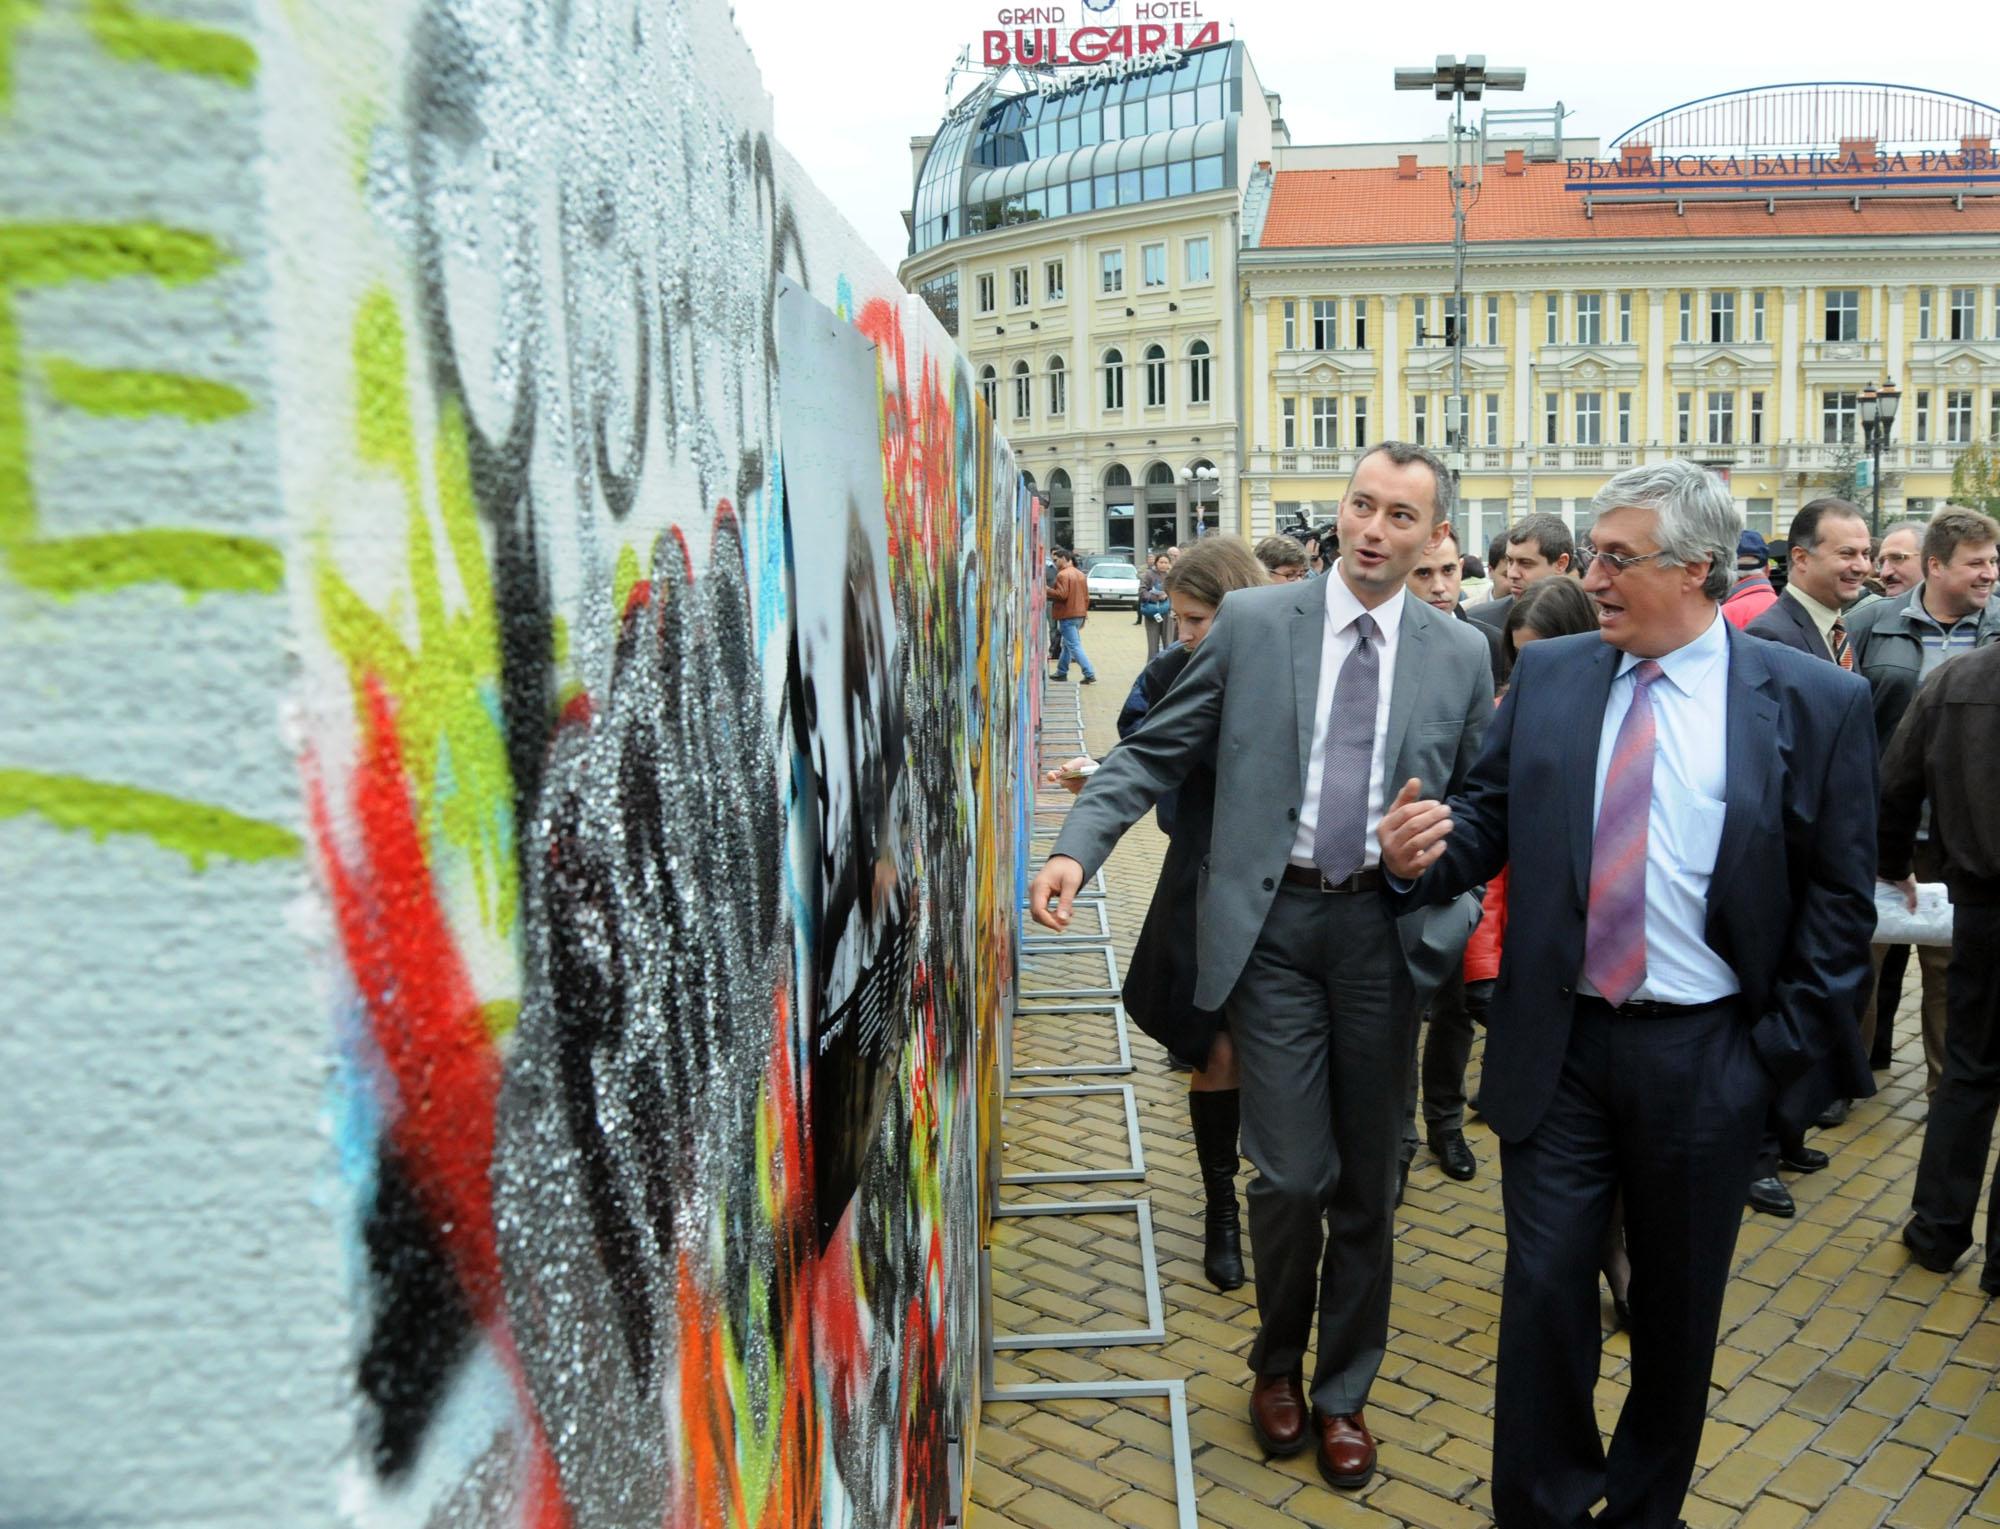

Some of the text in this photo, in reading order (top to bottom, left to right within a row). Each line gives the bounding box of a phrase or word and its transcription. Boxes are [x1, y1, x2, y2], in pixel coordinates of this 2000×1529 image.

[998, 1, 1203, 25] GRAND HOTEL
[983, 21, 1220, 67] BULGARIA
[1039, 49, 1182, 97] BNP PARIBAS
[1565, 154, 1743, 179] БЪЛГАРСКА
[1752, 151, 1864, 175] БАНКА
[1872, 151, 1909, 172] ЗА
